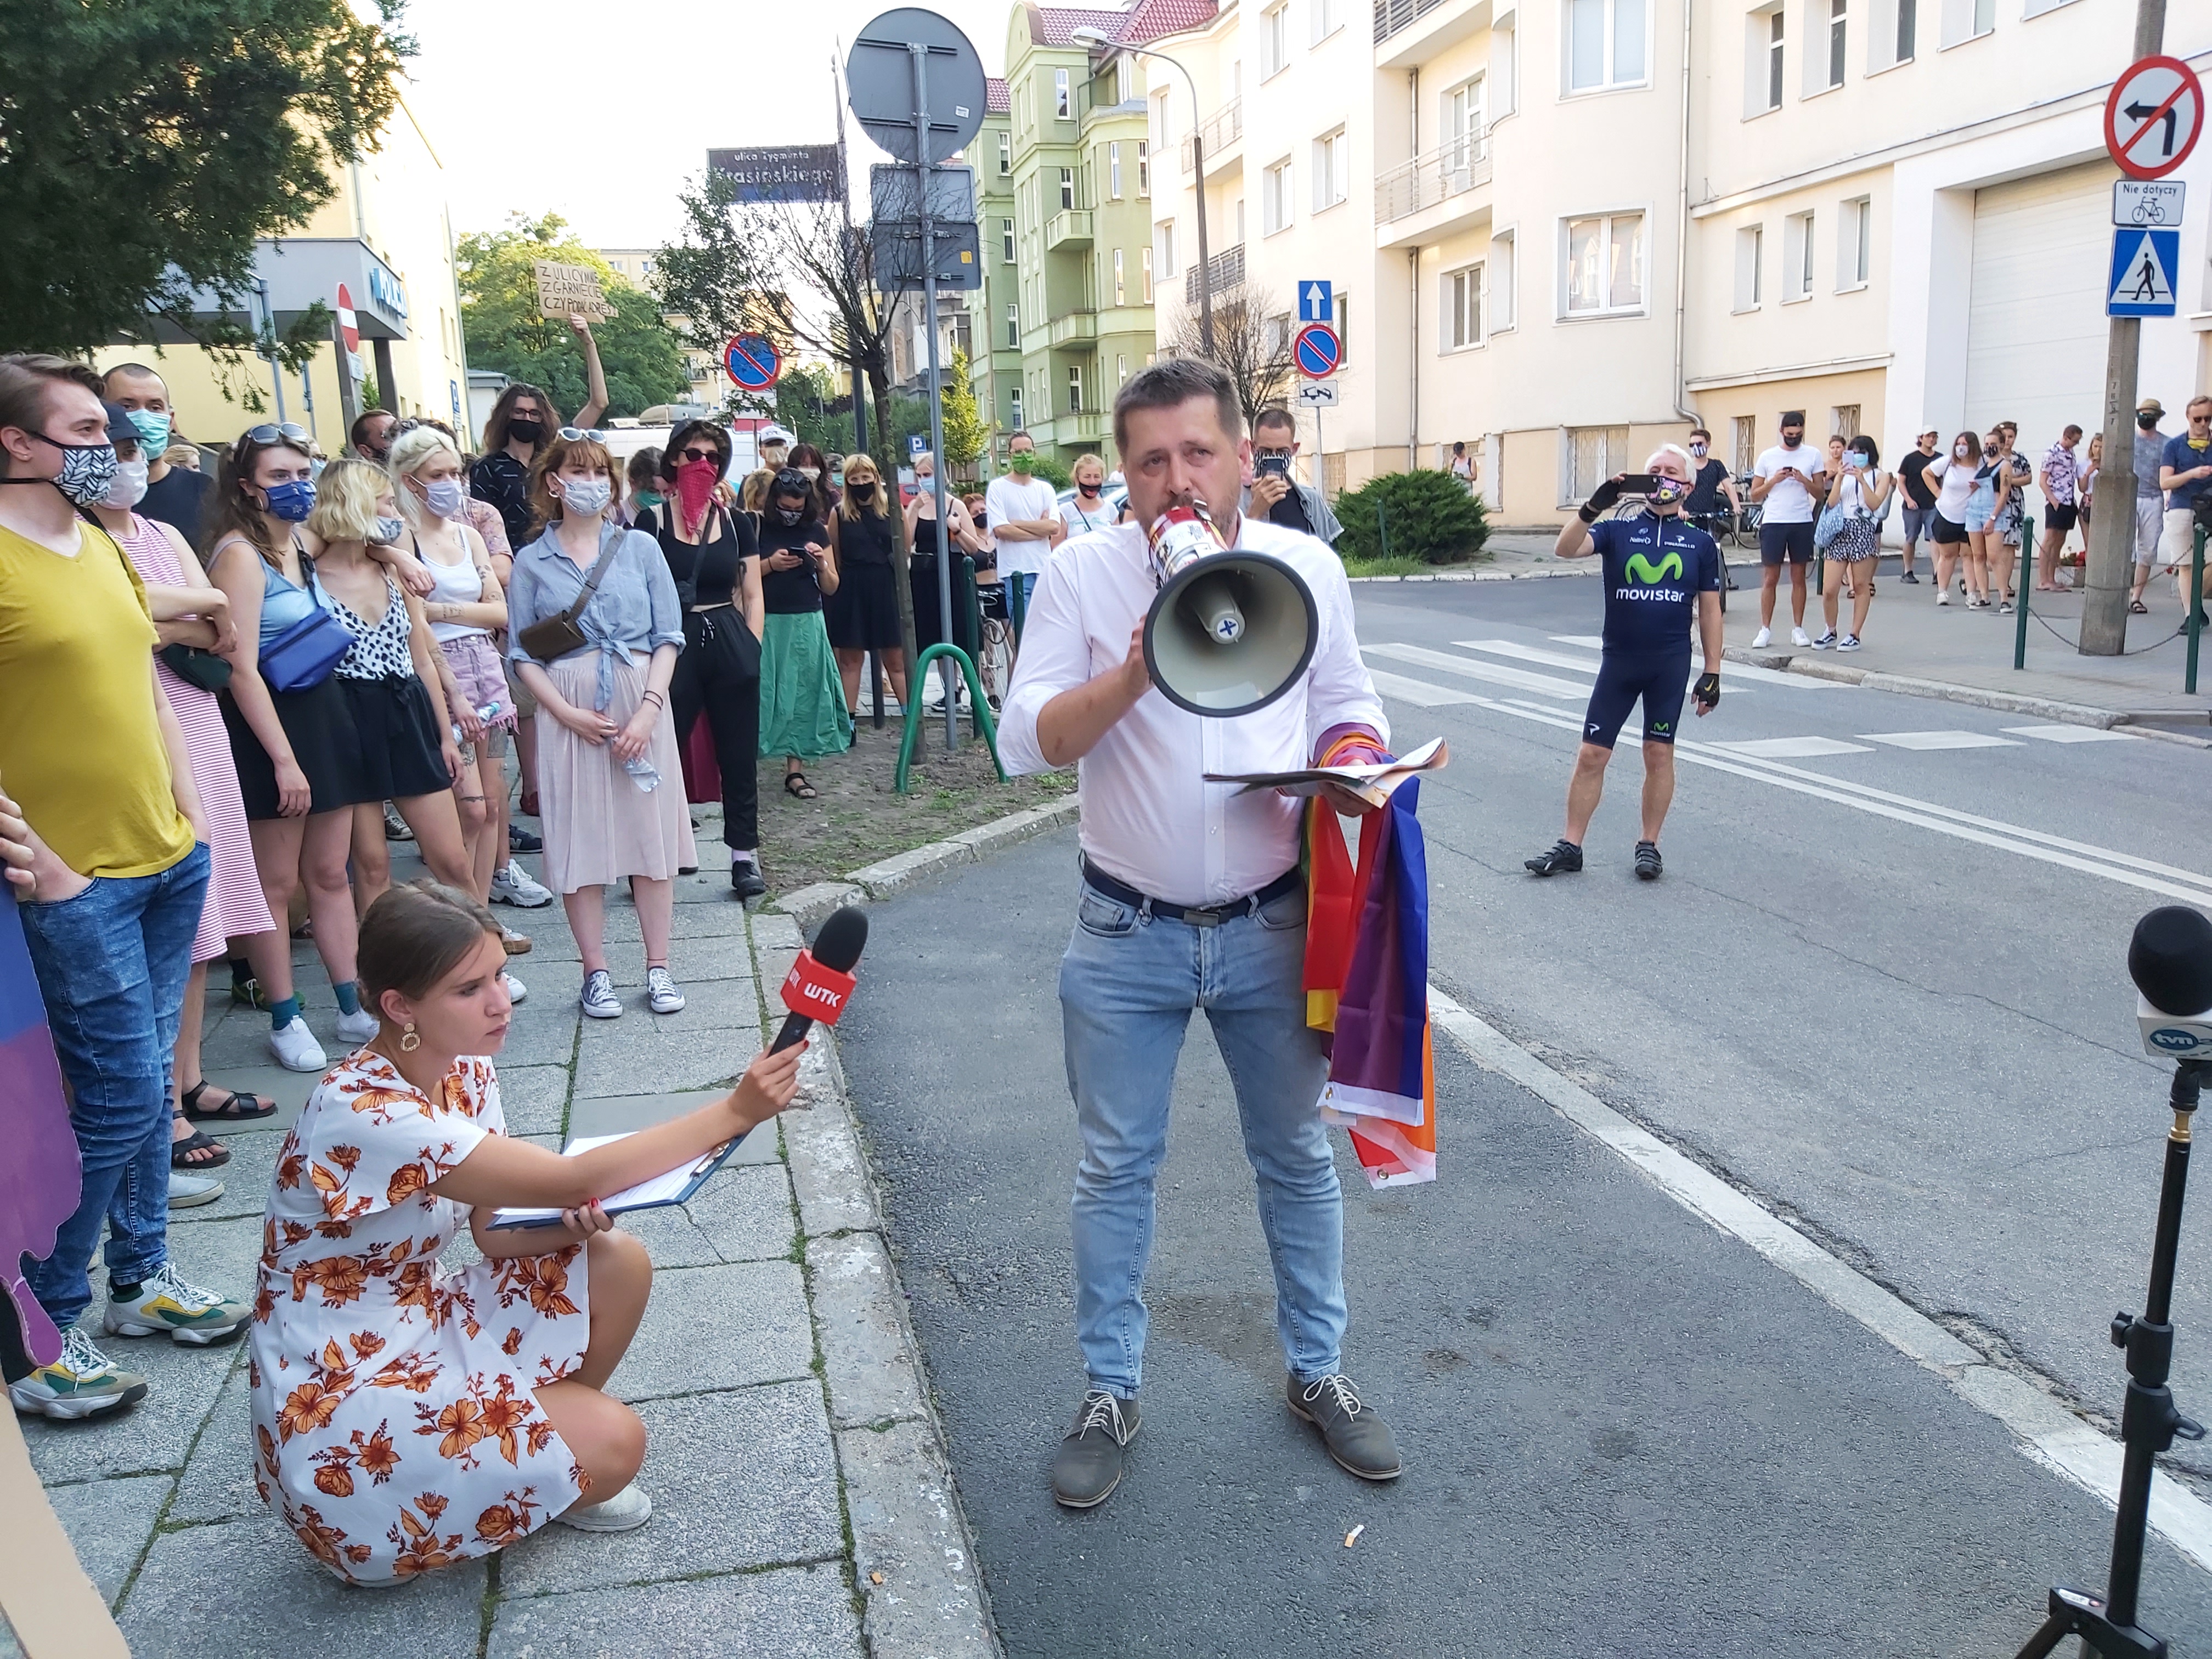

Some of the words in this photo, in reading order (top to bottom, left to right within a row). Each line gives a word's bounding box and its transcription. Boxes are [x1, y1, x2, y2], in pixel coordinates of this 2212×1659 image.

[734, 151, 758, 161] ulica
[2123, 183, 2139, 194] Nie
[2143, 184, 2177, 197] dotyczy
[538, 266, 551, 278] Z
[544, 297, 566, 312] CZY
[1616, 588, 1685, 603] movistar
[2154, 1032, 2194, 1046] tvn
